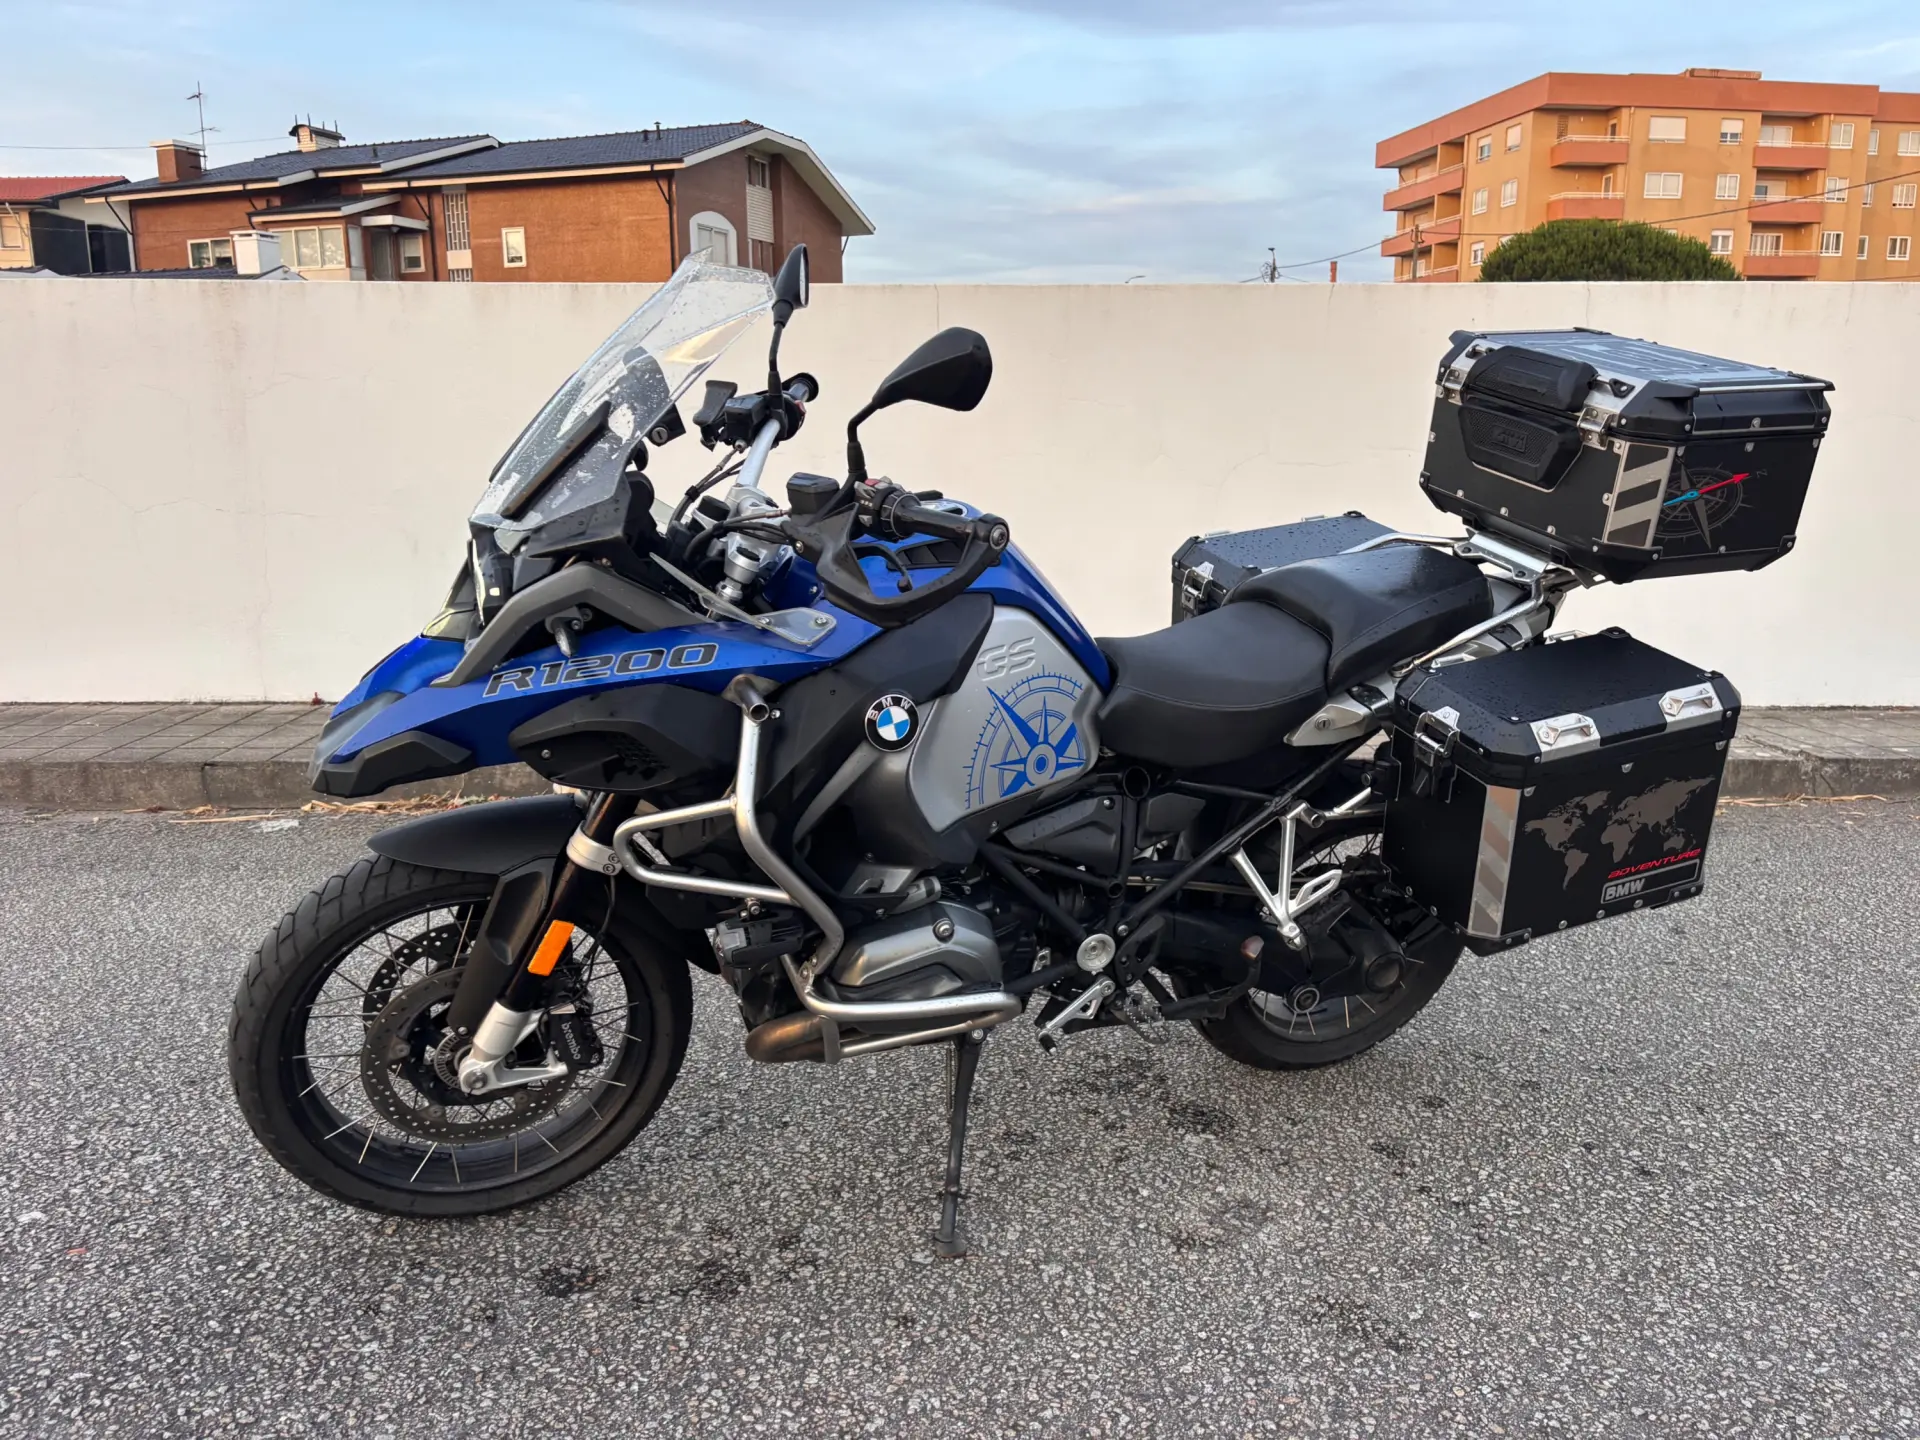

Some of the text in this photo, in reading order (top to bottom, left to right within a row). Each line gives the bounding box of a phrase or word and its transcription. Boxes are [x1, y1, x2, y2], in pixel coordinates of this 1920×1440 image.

[483, 643, 718, 697] R1200
[976, 637, 1036, 682] GS
[1605, 878, 1646, 901] BMW
[561, 1021, 581, 1060] brembo
